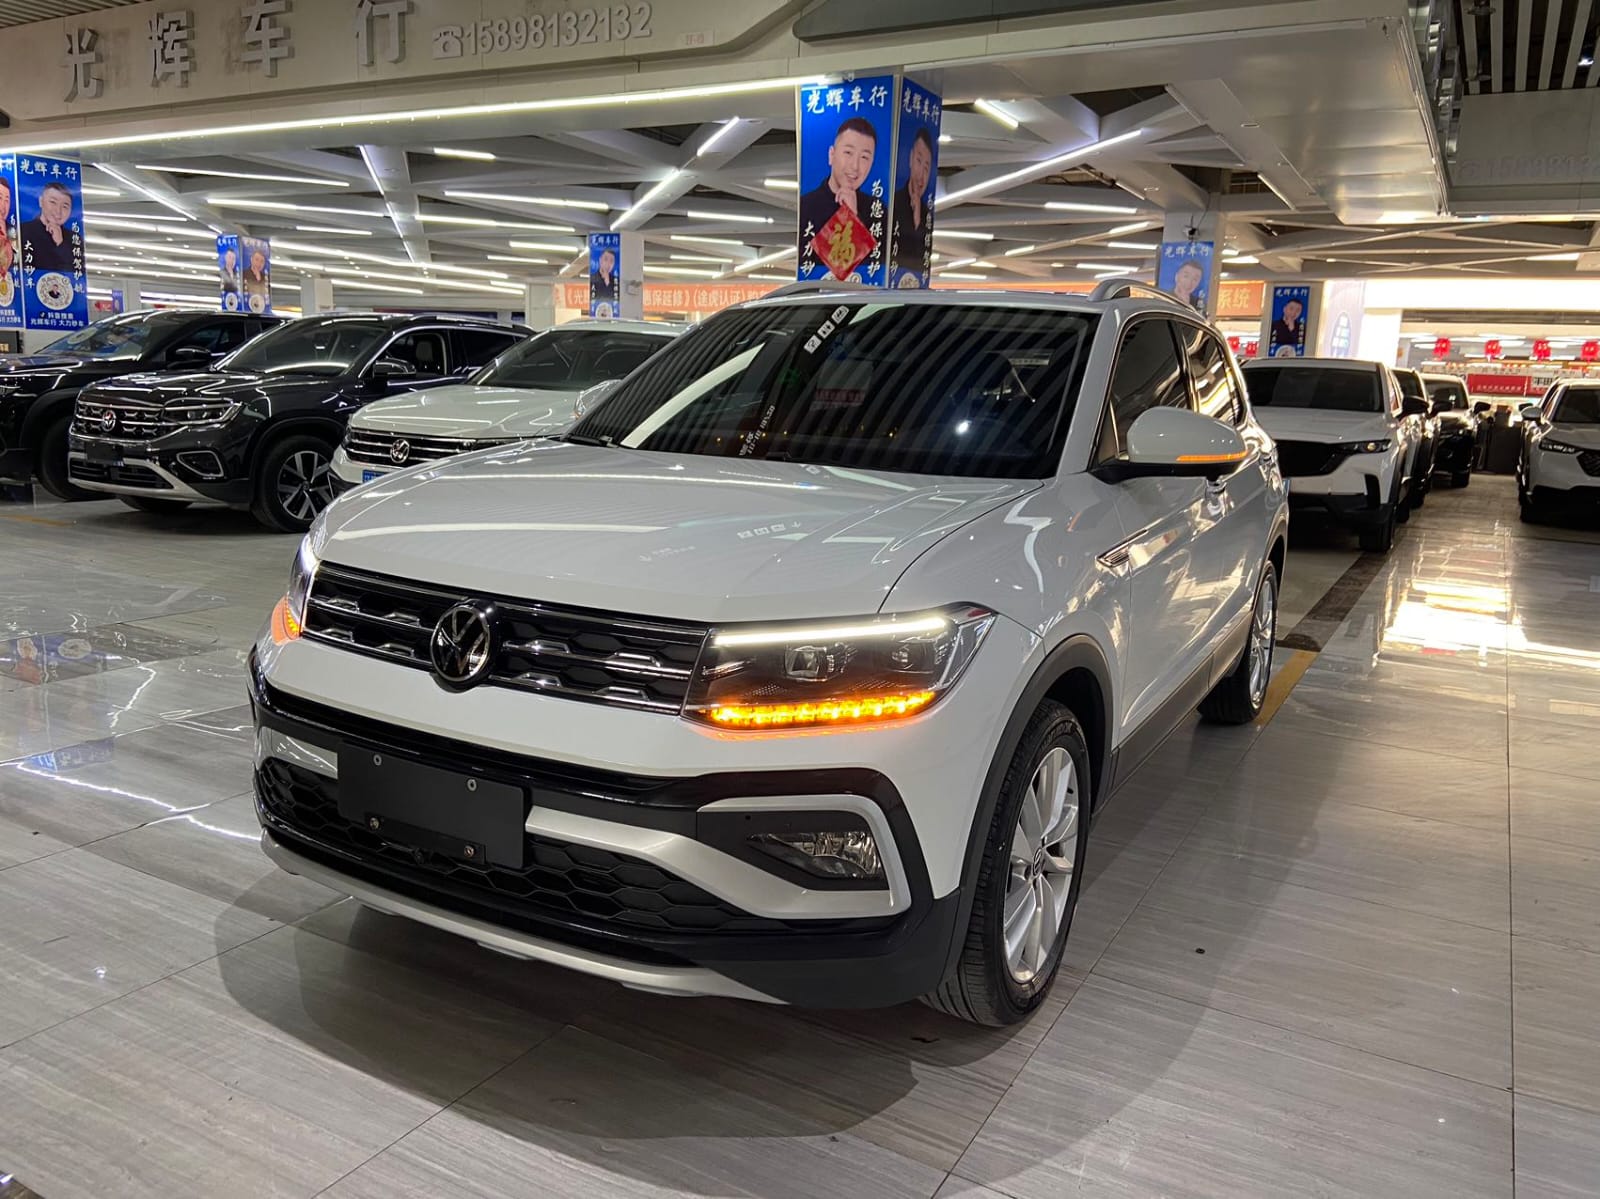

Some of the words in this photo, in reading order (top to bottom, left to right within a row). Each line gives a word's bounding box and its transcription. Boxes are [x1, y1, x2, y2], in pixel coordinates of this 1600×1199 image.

[465, 2, 653, 55] 15898132132
[807, 85, 889, 114] 光辉车行
[902, 87, 940, 126] 光辉车行
[20, 159, 78, 180] 光辉车行
[866, 179, 885, 286] 为您保驾护
